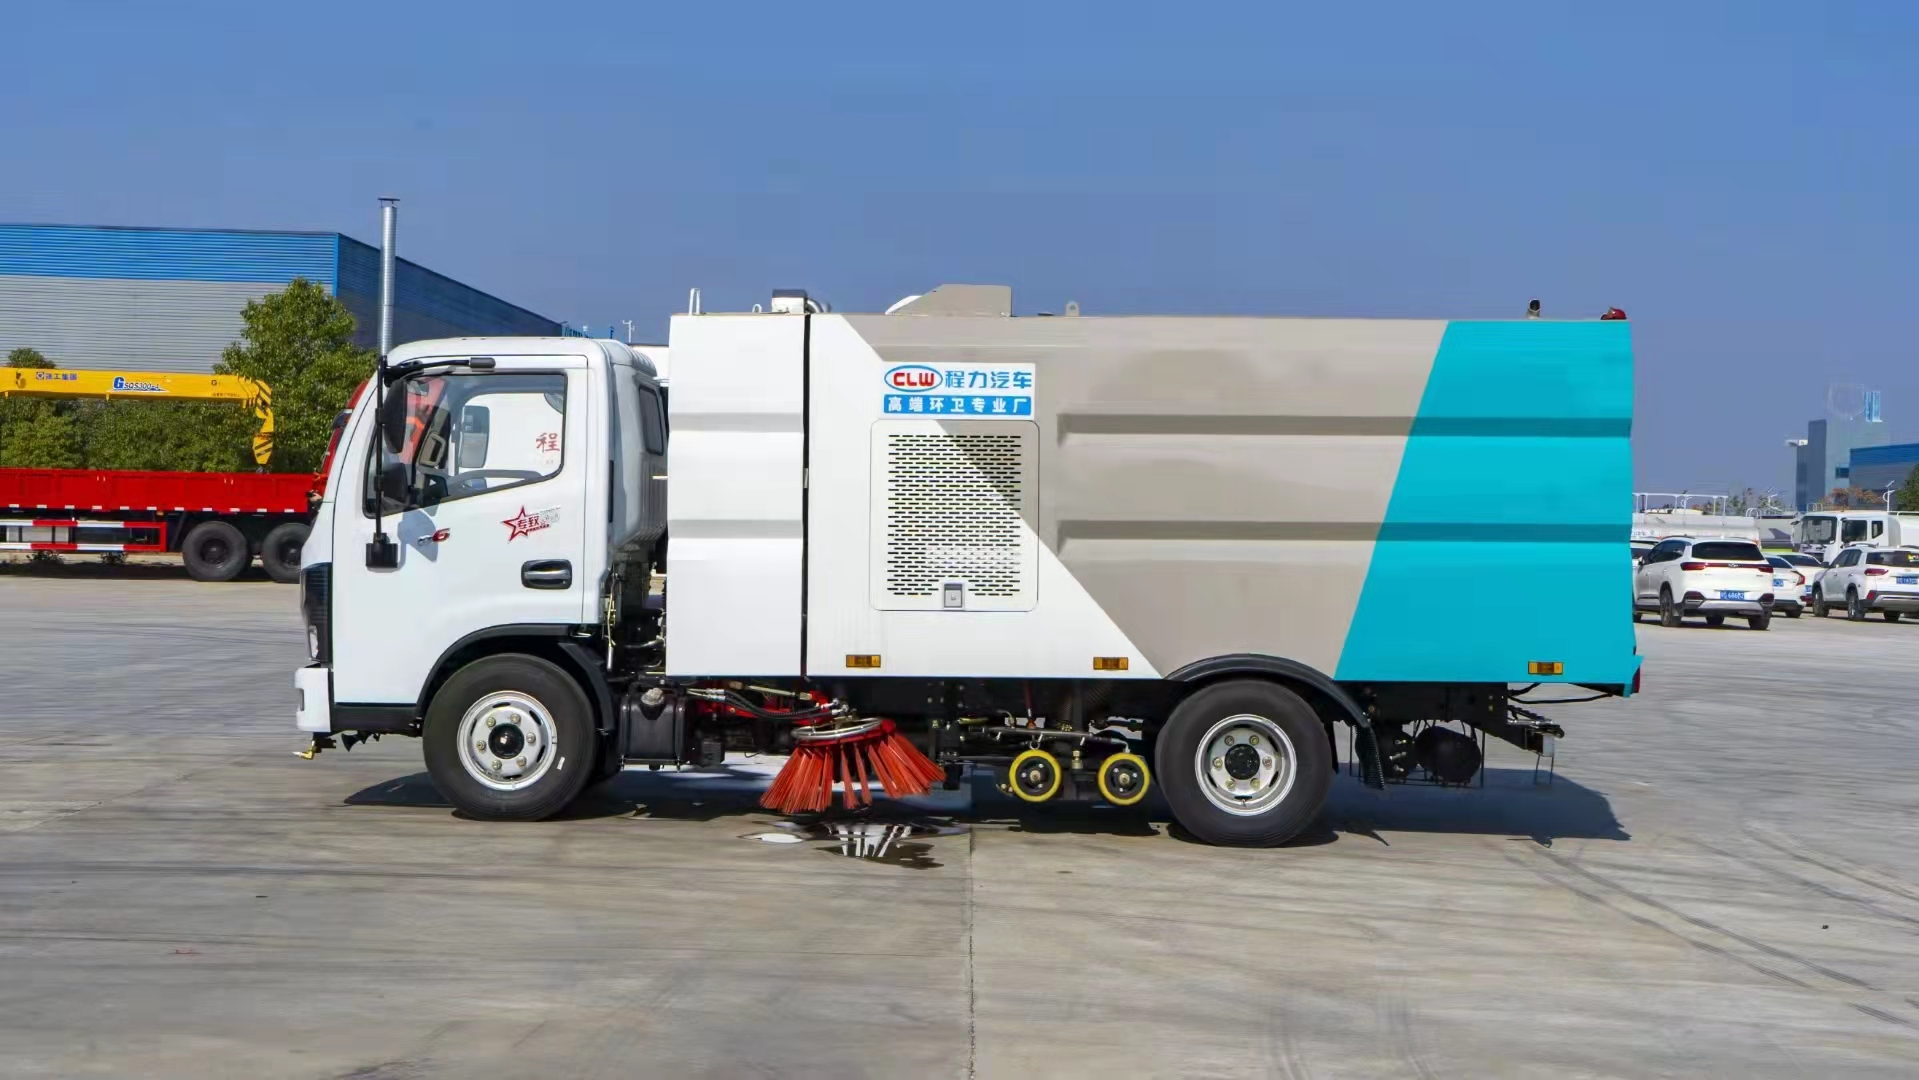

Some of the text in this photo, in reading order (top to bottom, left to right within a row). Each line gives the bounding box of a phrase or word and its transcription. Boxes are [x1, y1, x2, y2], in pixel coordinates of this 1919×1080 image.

[893, 370, 1032, 389] CLW 程力汽车
[888, 396, 1027, 413] 高端环卫专业厂
[535, 432, 560, 453] 程
